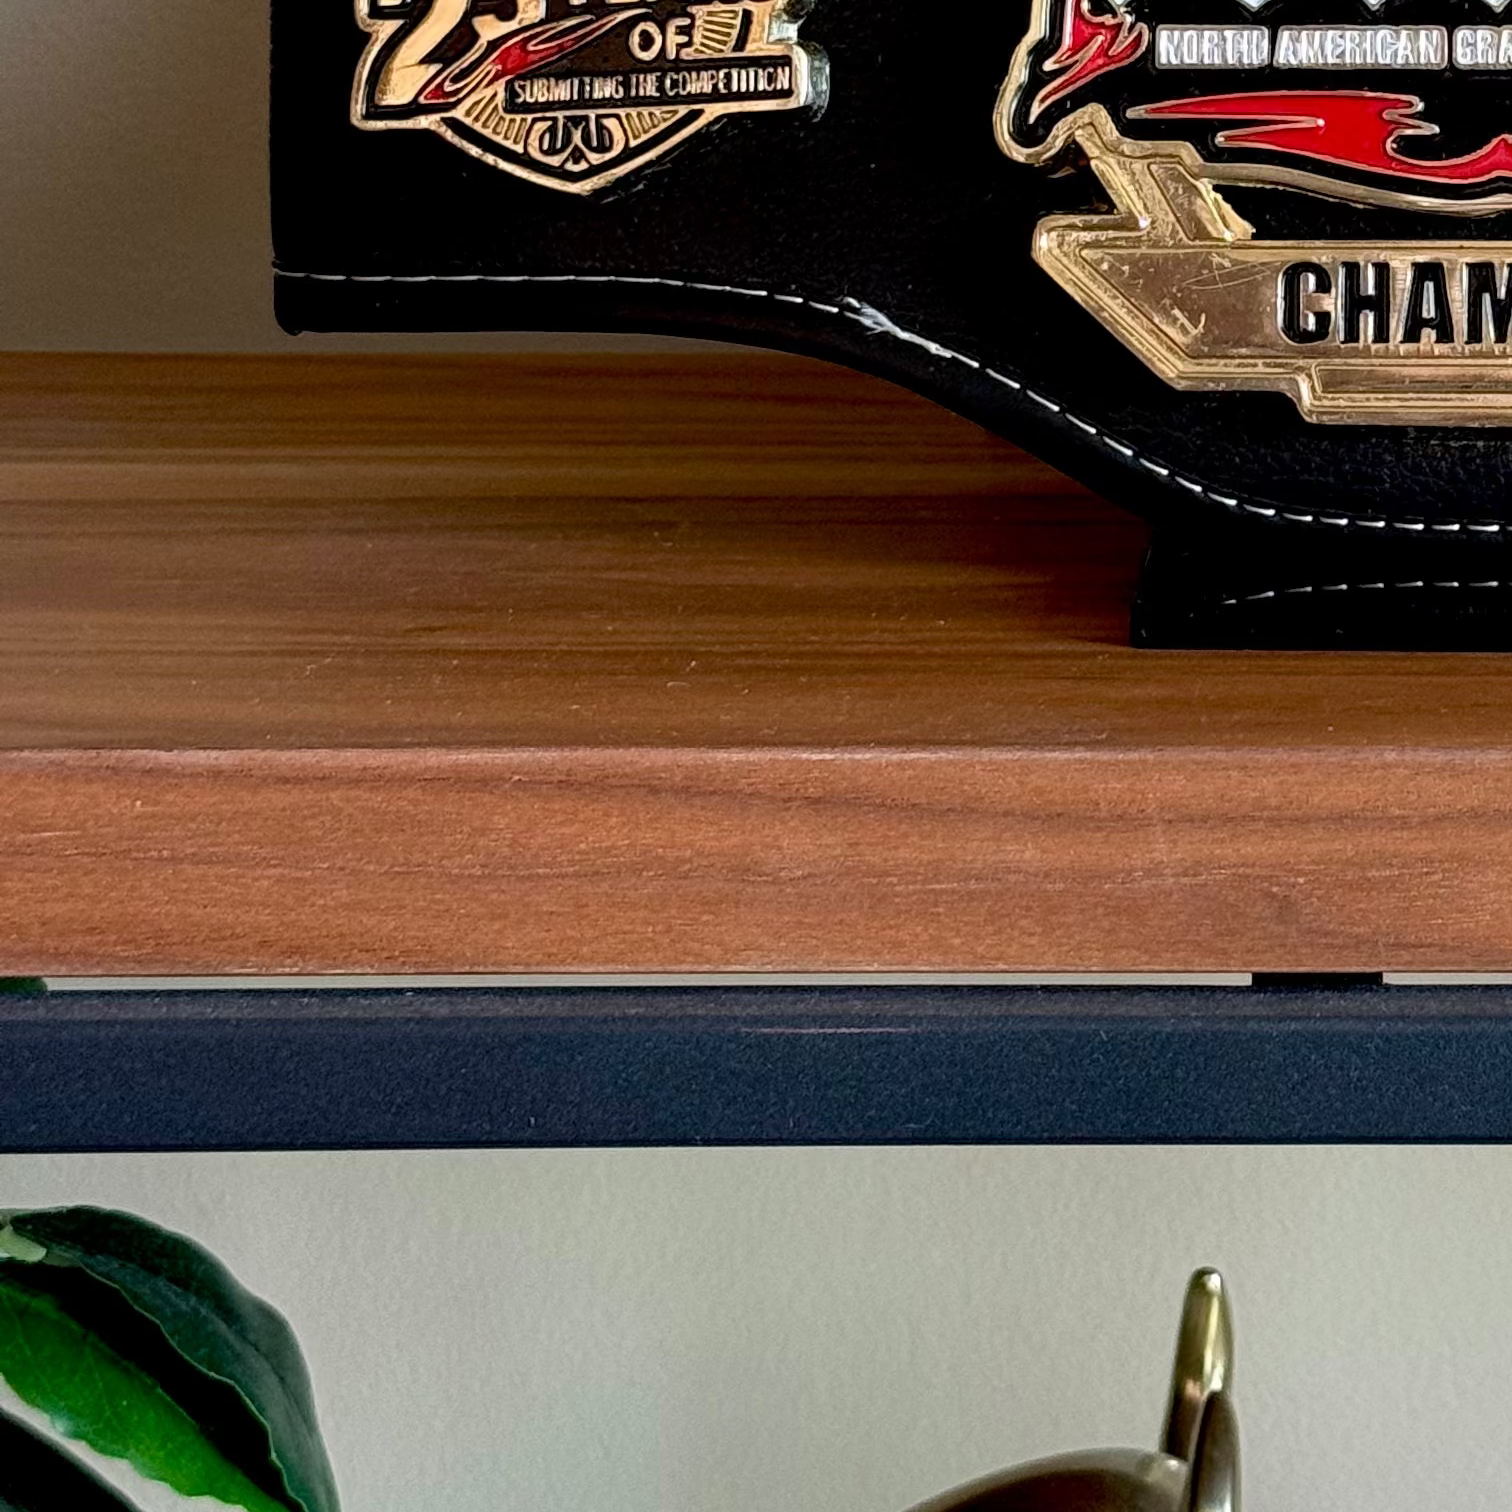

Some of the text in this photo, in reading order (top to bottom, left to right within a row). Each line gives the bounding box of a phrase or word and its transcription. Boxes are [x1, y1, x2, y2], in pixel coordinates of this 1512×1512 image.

[627, 16, 693, 62] OF
[1158, 28, 1269, 66] NORTH
[1276, 28, 1446, 66] AMERICAN
[513, 66, 791, 104] SUBMITTING THE COMPETITION
